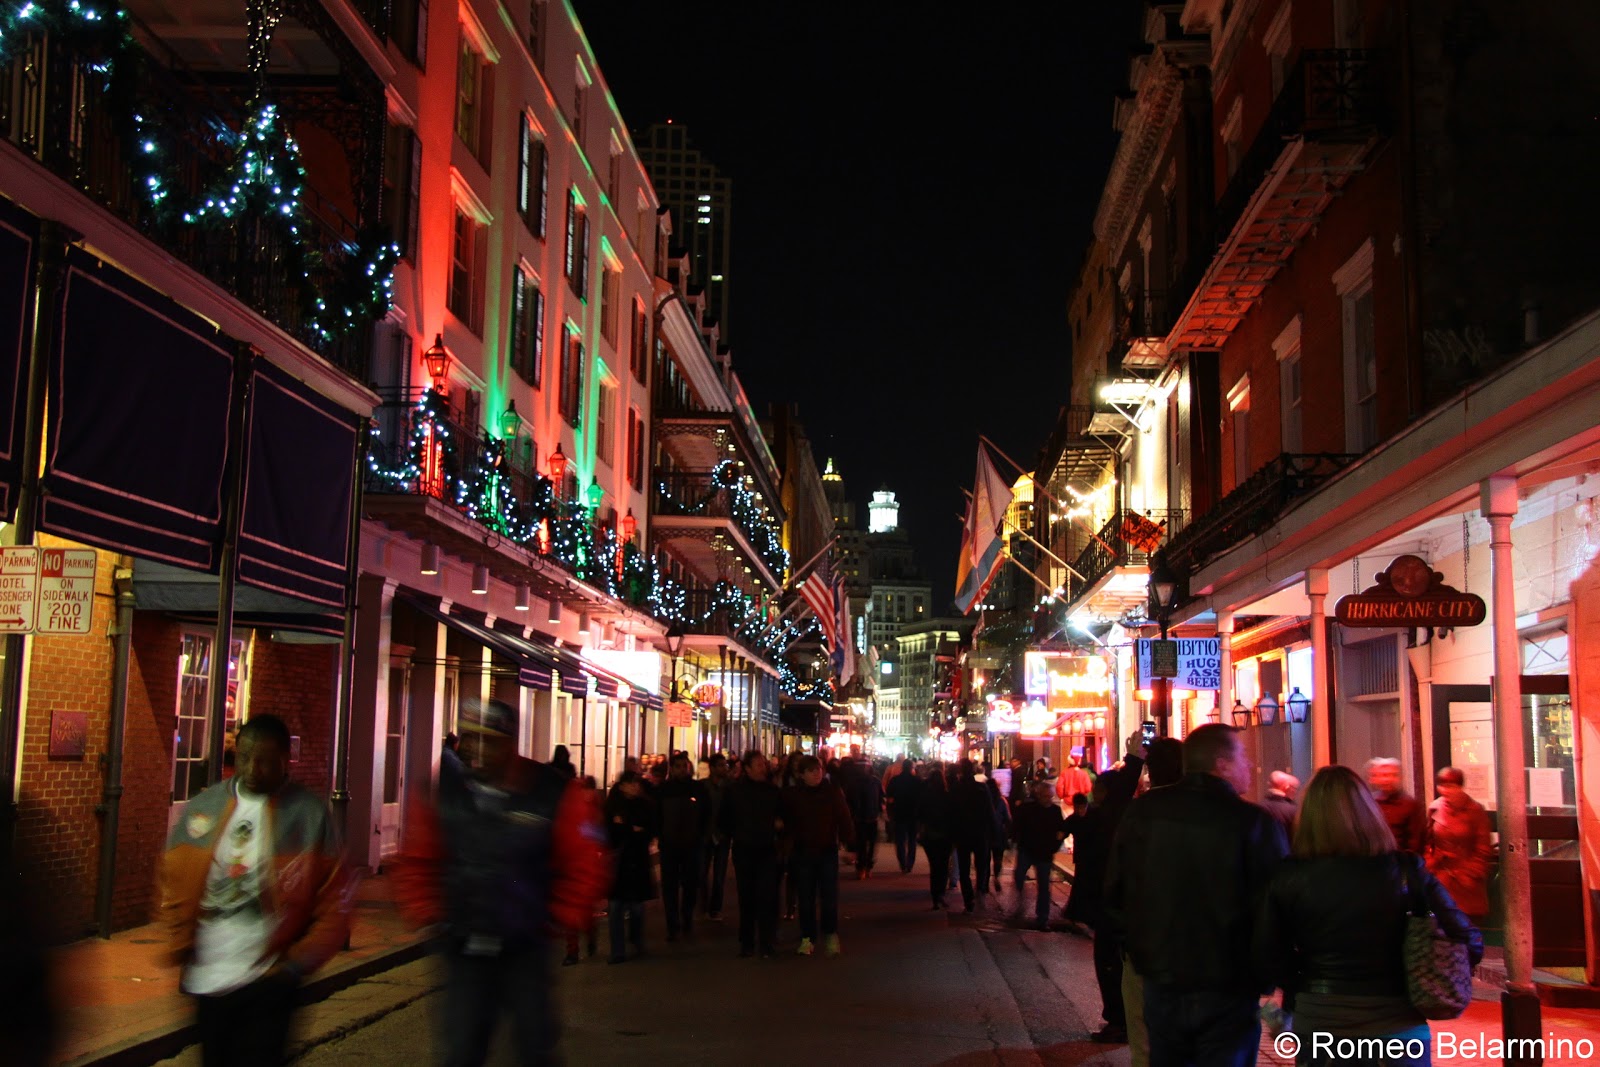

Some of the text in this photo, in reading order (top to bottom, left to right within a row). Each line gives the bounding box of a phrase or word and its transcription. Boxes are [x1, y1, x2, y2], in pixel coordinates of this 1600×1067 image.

[4, 556, 36, 567] PARKING
[44, 553, 94, 571] NO PARKING
[0, 578, 26, 589] OTEL
[60, 579, 74, 589] ON
[43, 590, 89, 602] SIDEWALK
[47, 602, 82, 616] $200
[1347, 601, 1478, 619] HURRICANE CITY
[49, 616, 82, 630] FINE
[1189, 668, 1220, 677] ASS
